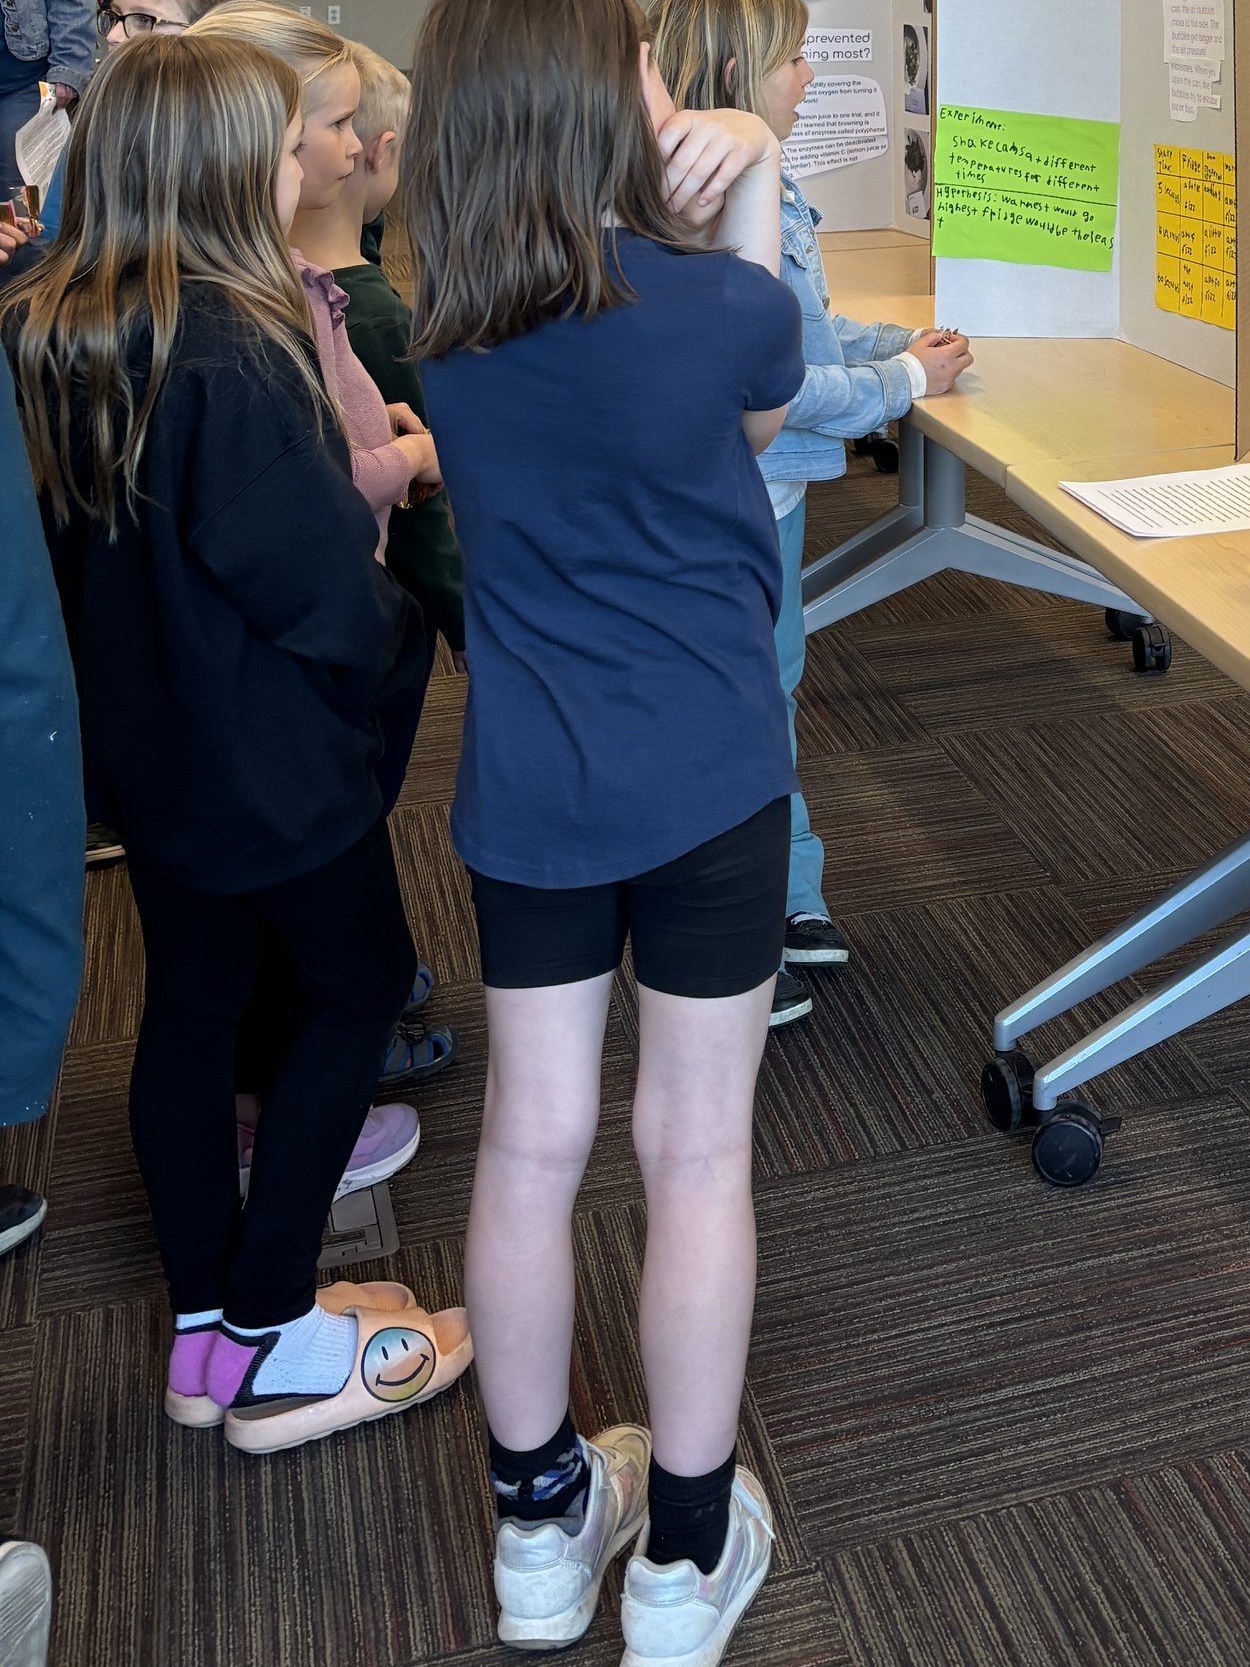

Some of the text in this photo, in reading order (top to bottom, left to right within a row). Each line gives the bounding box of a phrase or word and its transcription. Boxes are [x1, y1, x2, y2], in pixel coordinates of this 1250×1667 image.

[806, 33, 870, 45] prevented
[833, 48, 870, 58] most?
[799, 144, 823, 153] enzymes
[845, 138, 876, 146] deactivated
[1047, 175, 1100, 192] different
